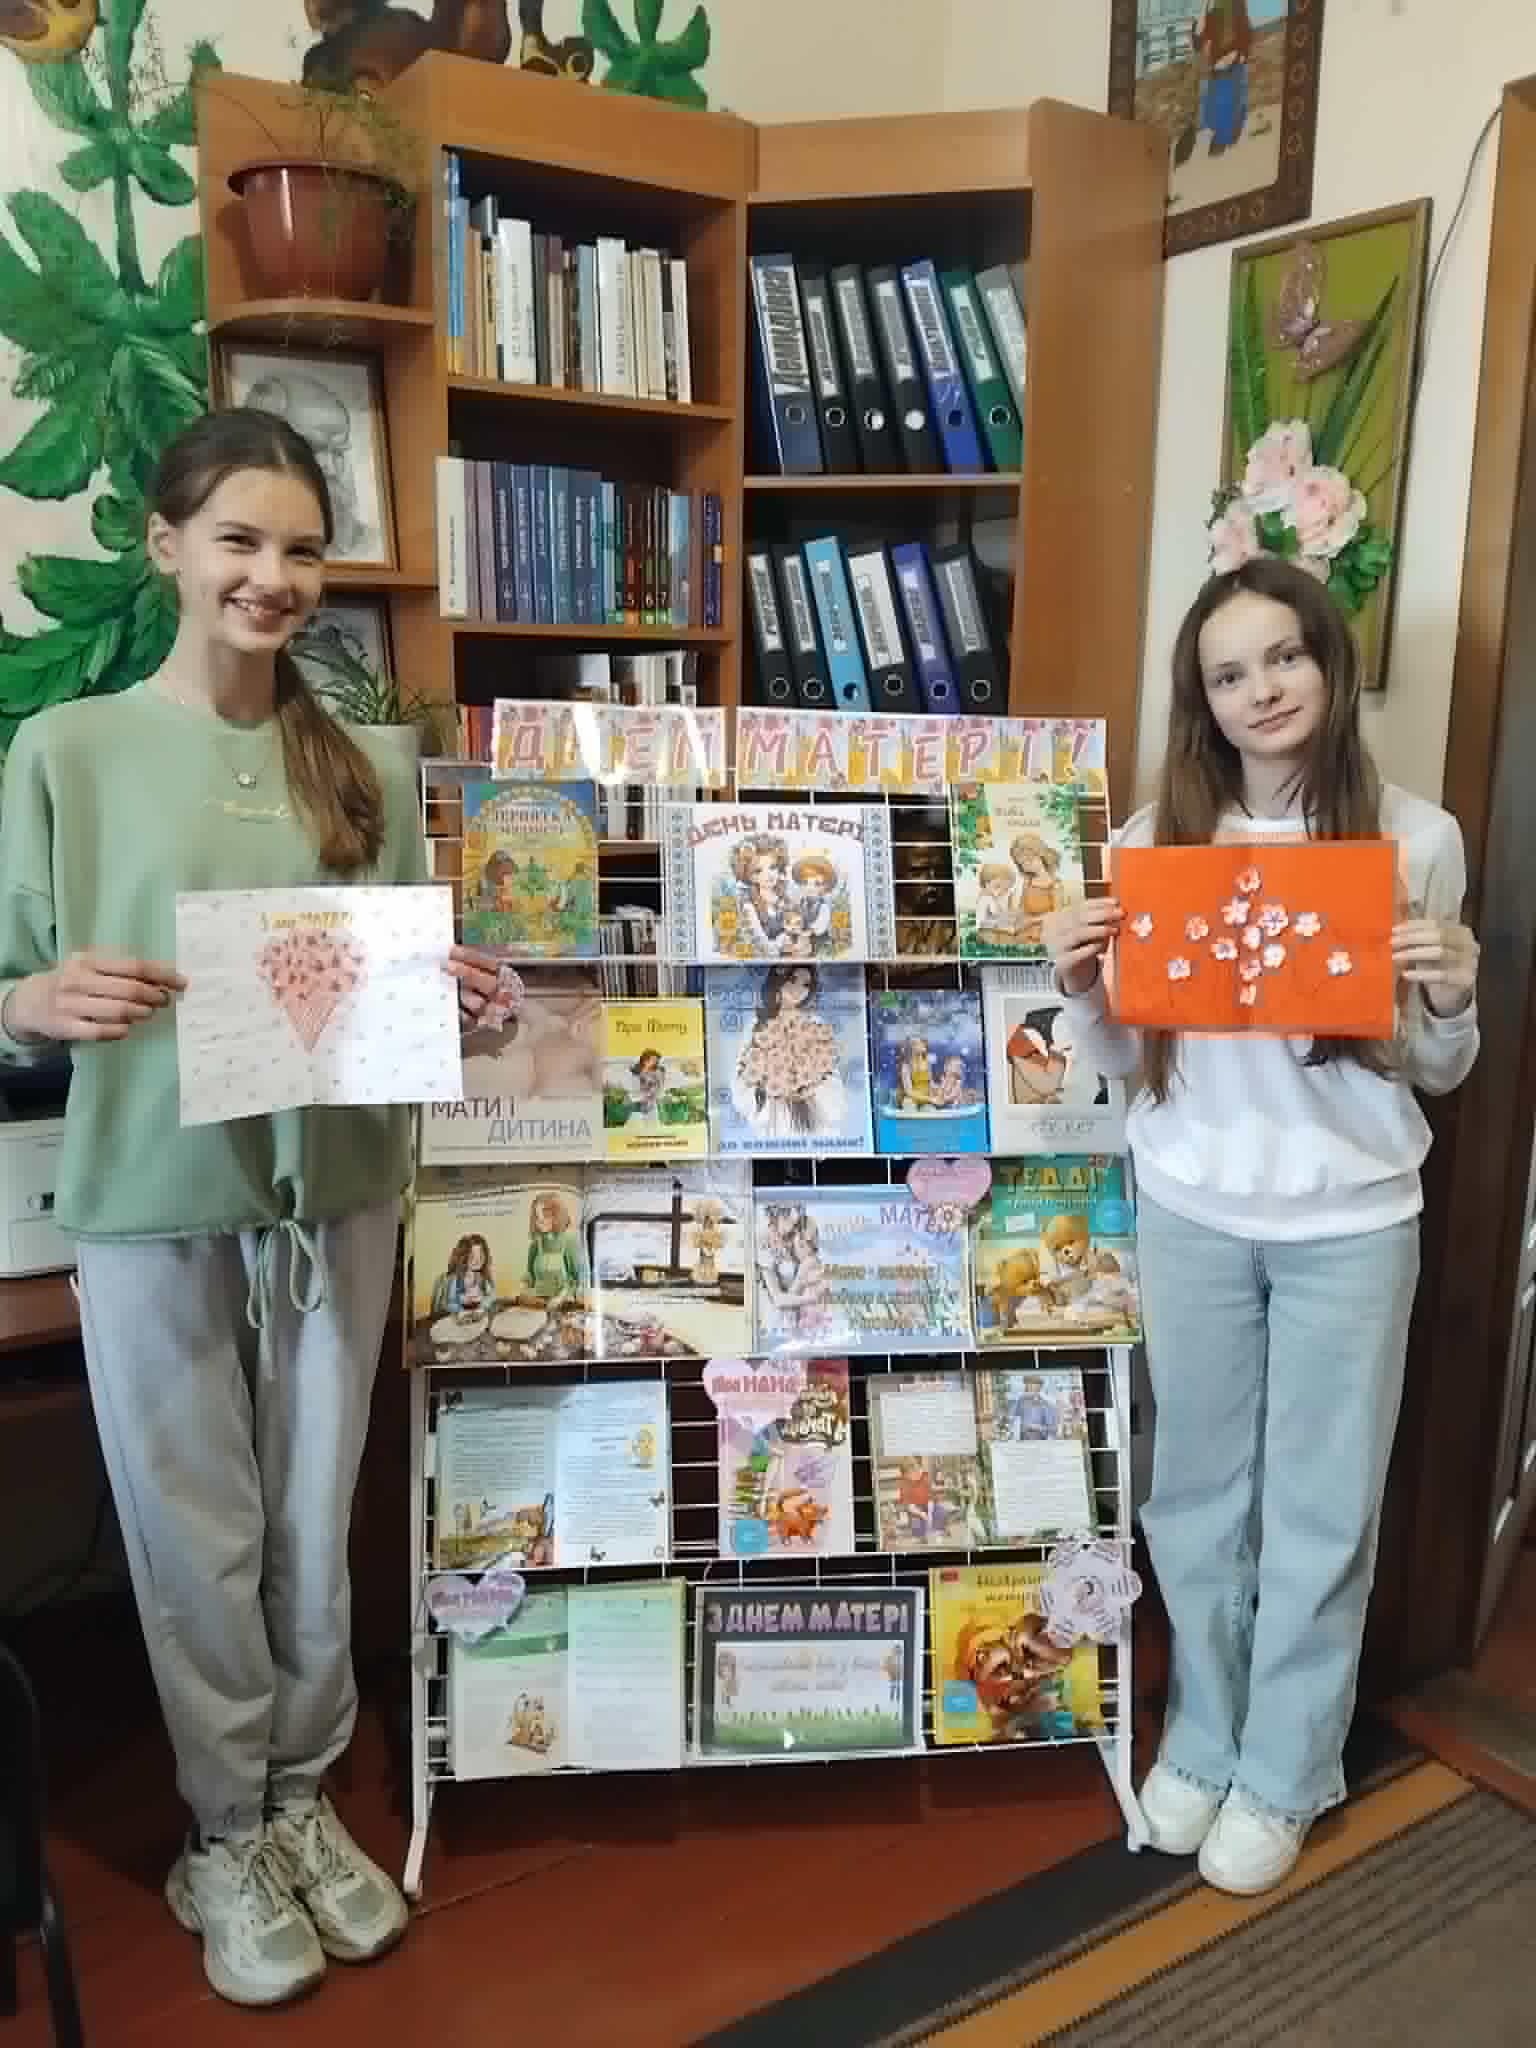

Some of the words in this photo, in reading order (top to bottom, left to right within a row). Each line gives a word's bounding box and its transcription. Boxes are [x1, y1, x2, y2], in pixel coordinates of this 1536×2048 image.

[487, 1120, 591, 1145] ДИТИНА
[703, 1602, 721, 1632] З
[724, 1601, 803, 1632] ДНЕМ
[806, 1601, 908, 1632] МАТЕРІ
